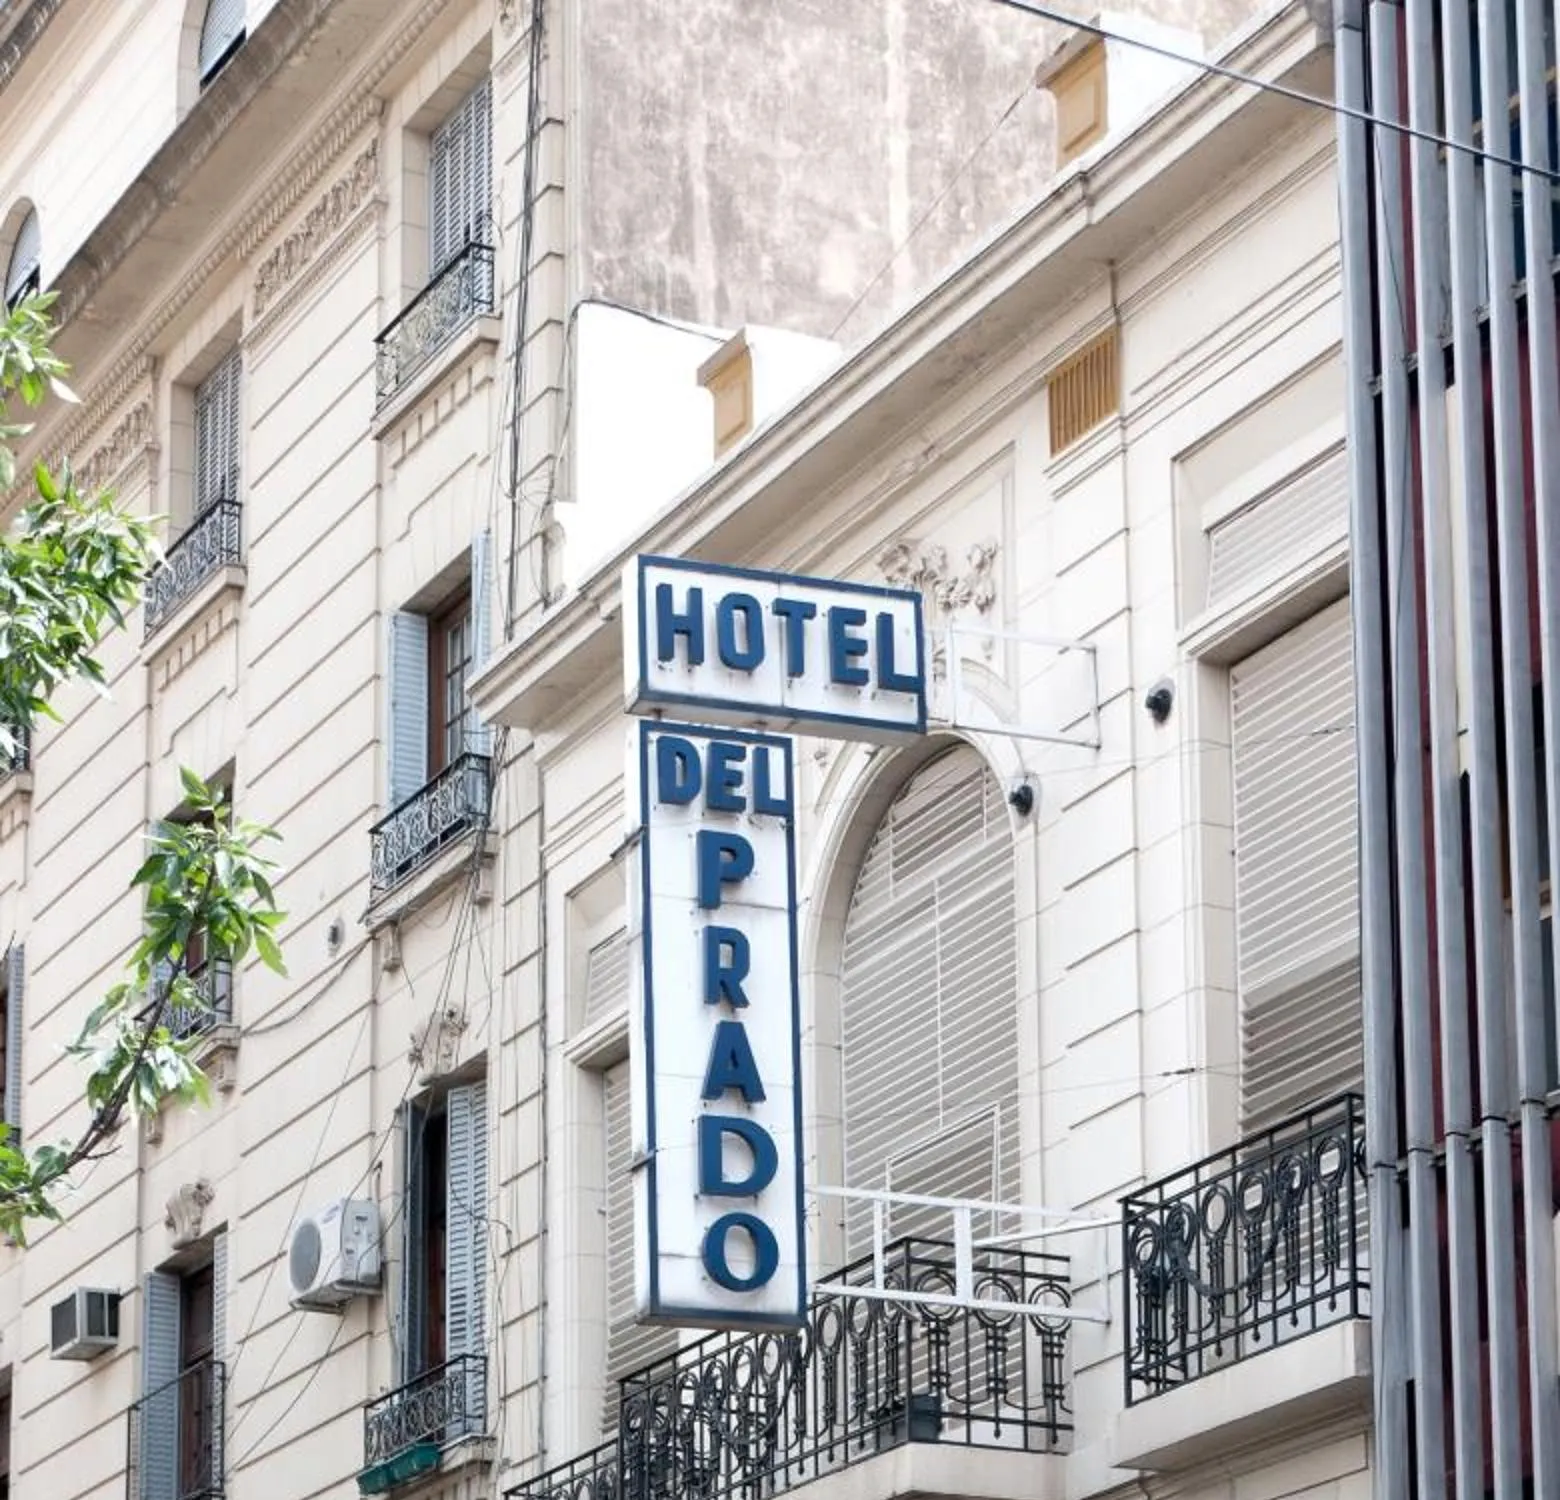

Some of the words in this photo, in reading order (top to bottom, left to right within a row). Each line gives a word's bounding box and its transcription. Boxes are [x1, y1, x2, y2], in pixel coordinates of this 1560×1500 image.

[656, 582, 922, 692] HOTEL
[656, 735, 793, 816] DEL
[697, 829, 779, 1293] PRADO
